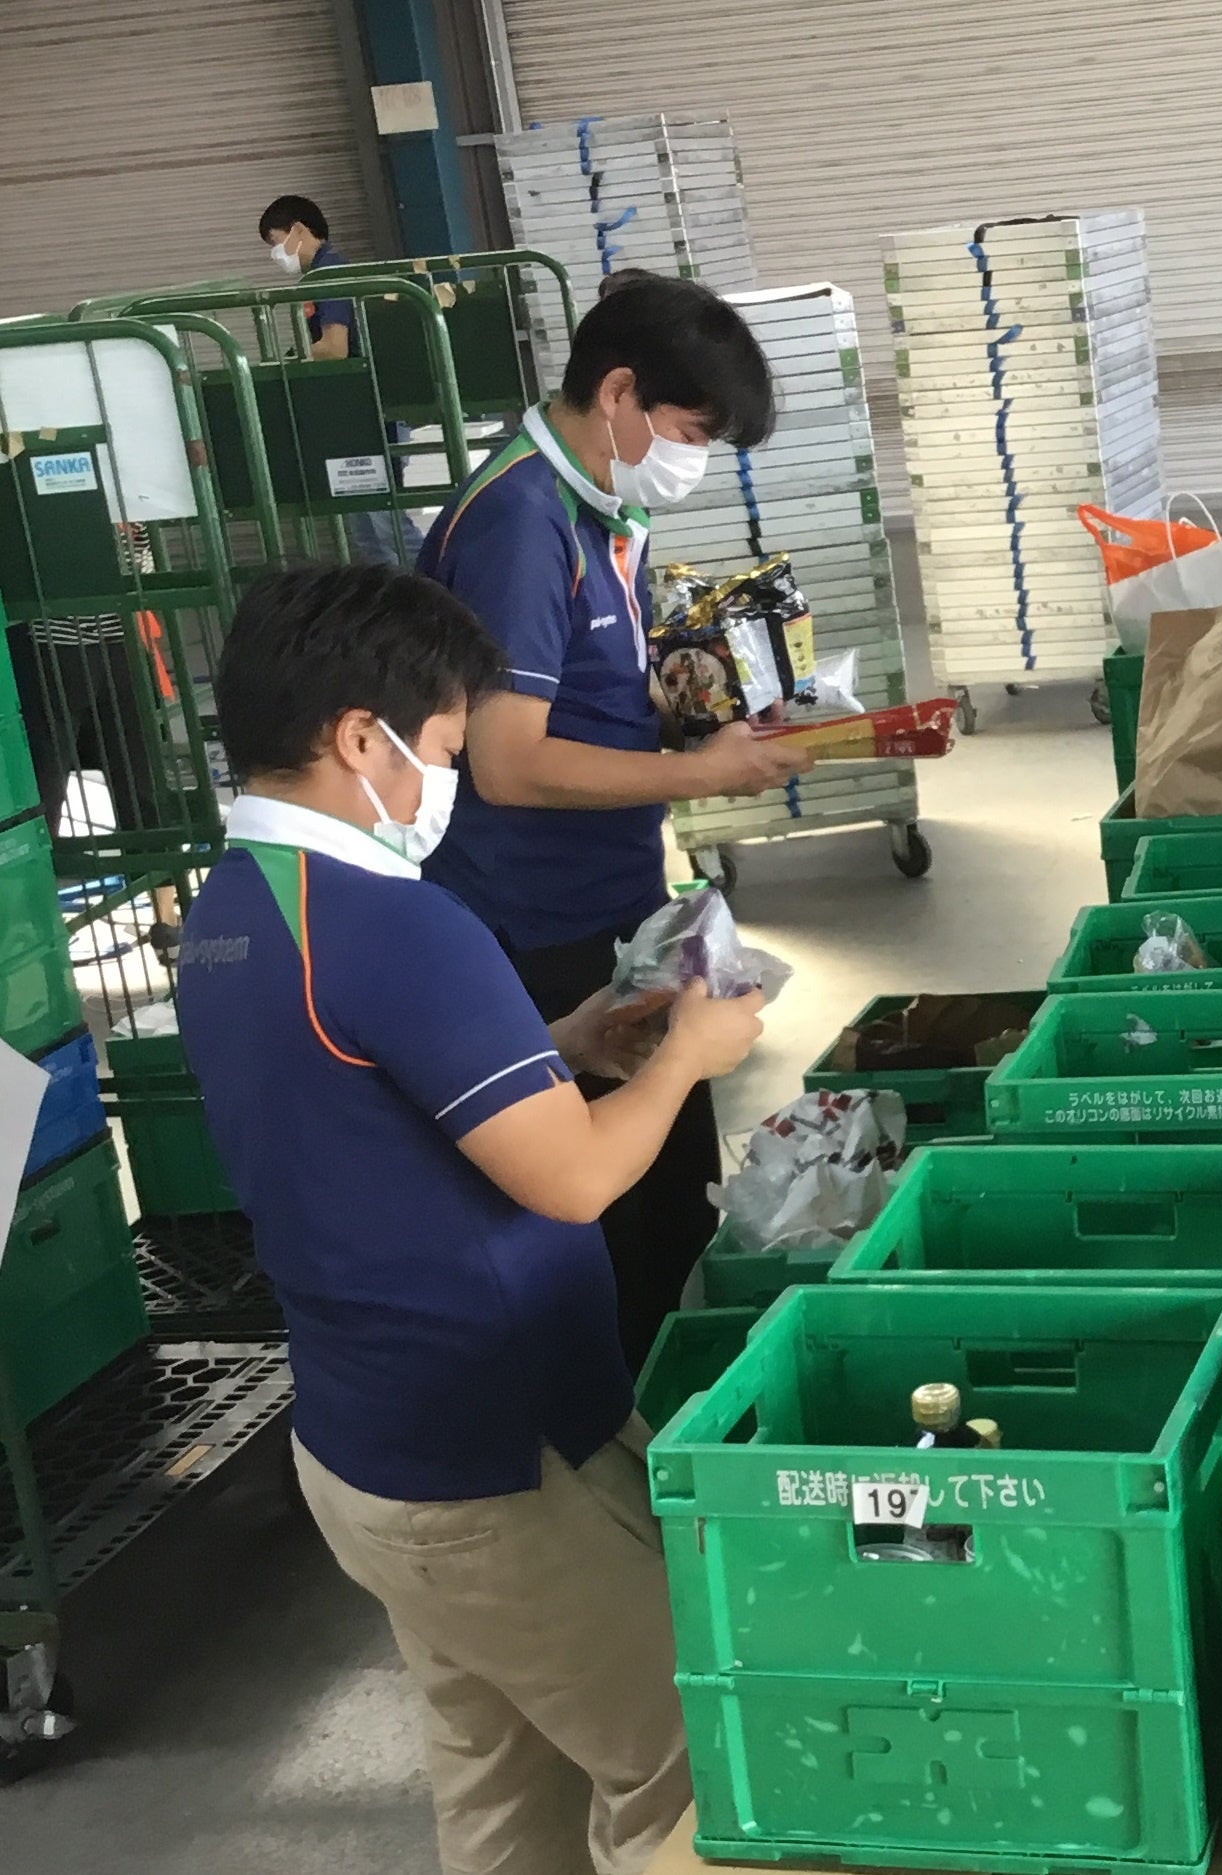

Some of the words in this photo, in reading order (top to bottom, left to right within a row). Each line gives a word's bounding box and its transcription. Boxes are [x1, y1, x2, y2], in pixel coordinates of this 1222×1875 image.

[34, 457, 91, 478] SANKA
[776, 1469, 1046, 1510] 配送時して下さい
